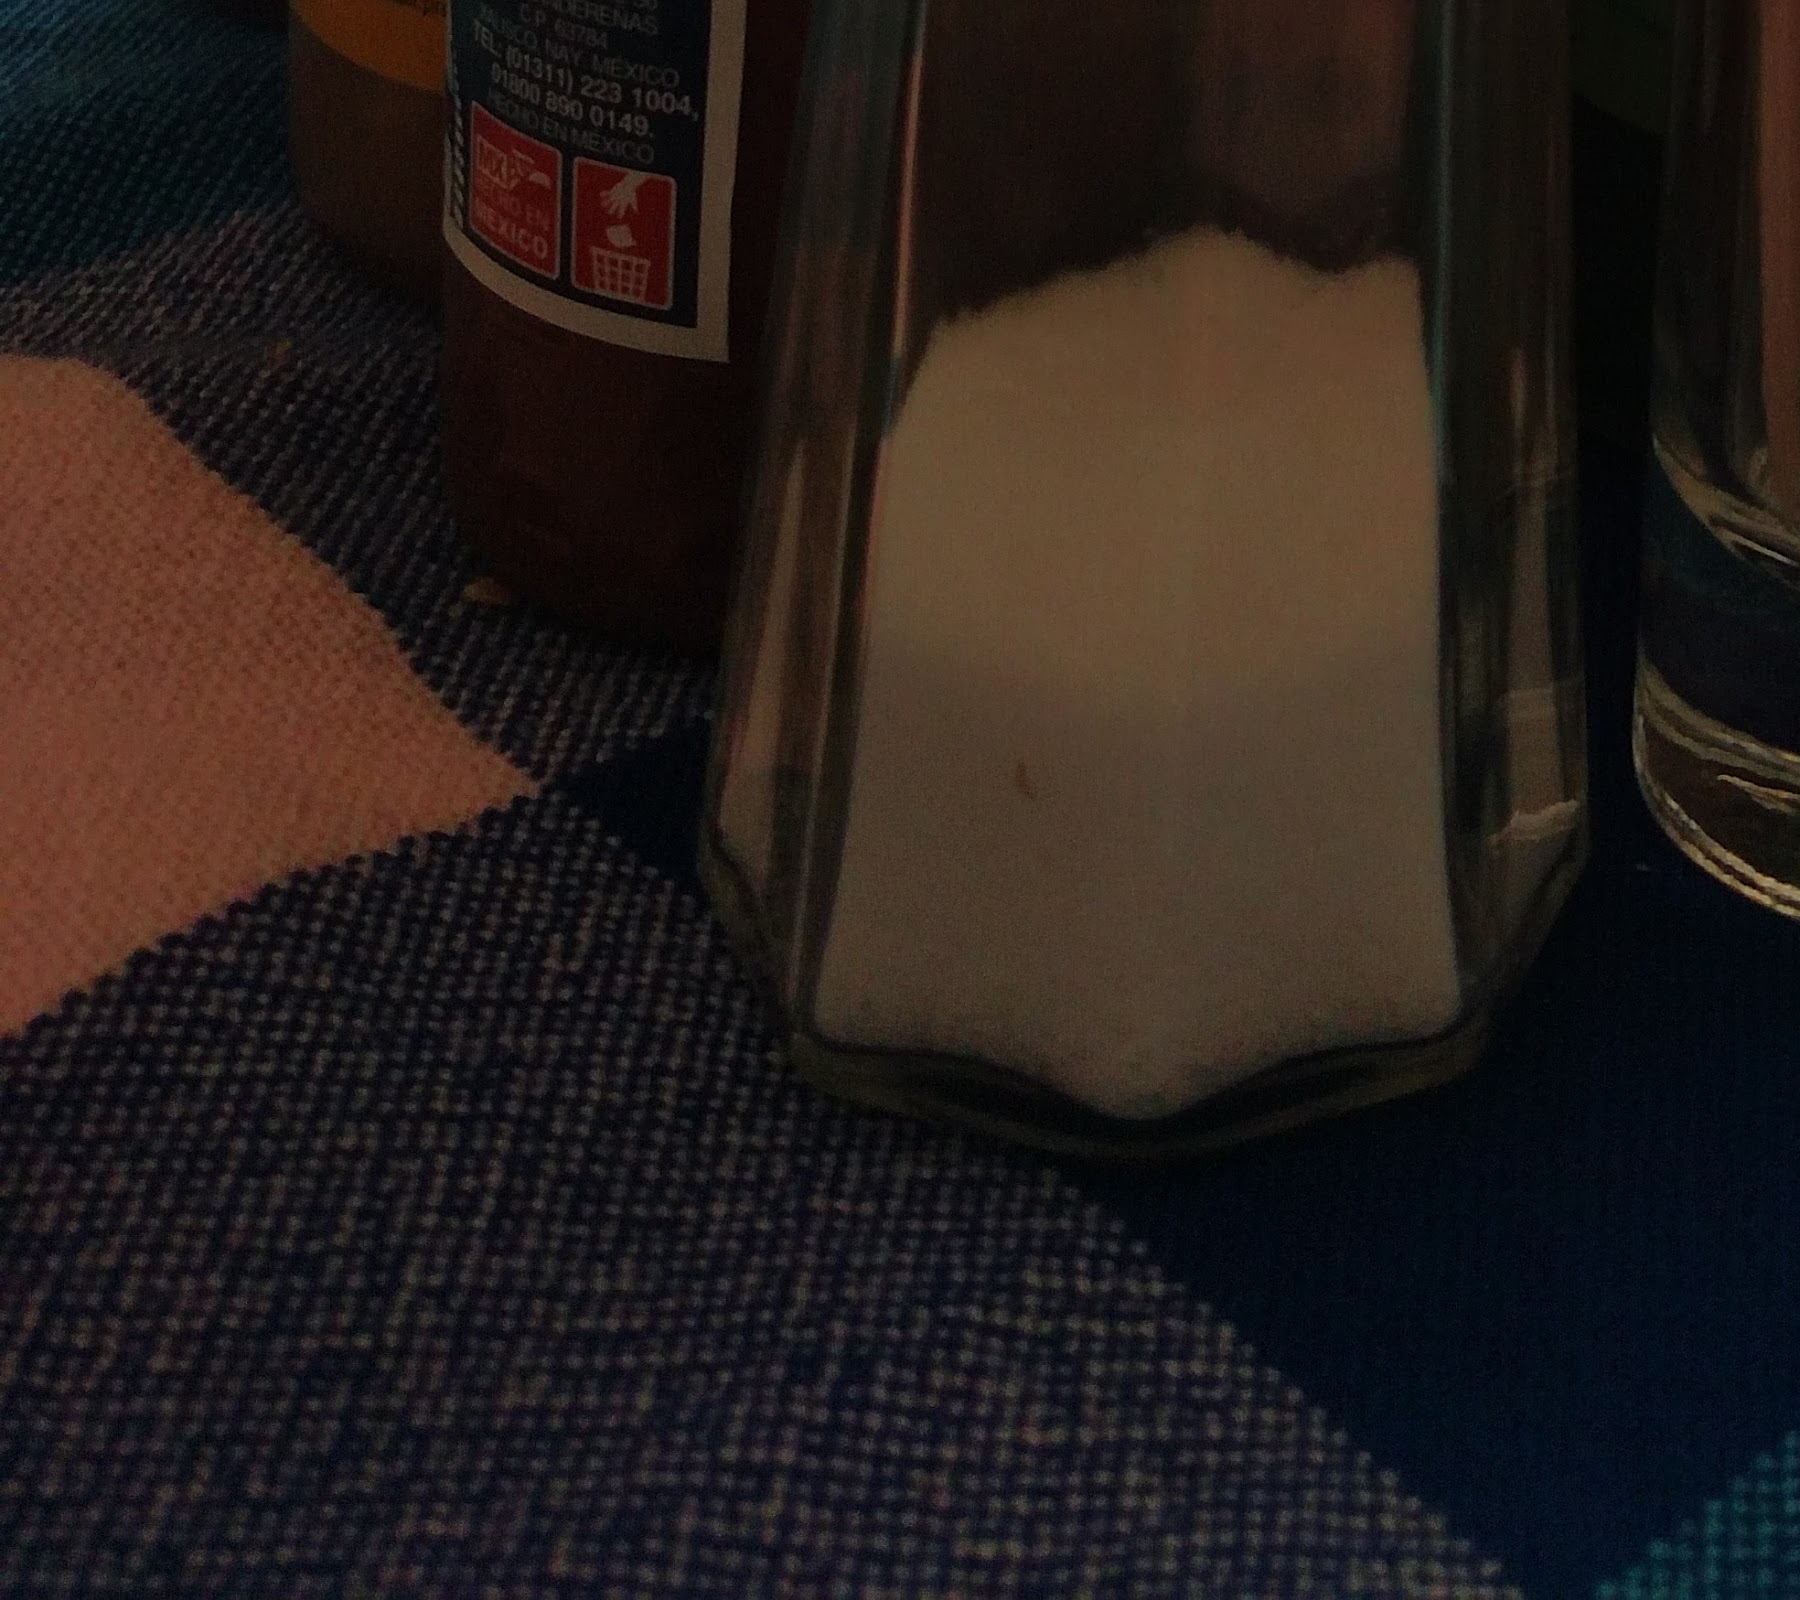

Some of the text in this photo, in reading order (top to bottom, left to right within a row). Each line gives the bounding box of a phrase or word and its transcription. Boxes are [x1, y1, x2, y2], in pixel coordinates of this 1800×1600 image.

[490, 61, 541, 107] 01800
[545, 89, 584, 122] 890
[580, 74, 624, 105] 223
[541, 116, 568, 145] EN
